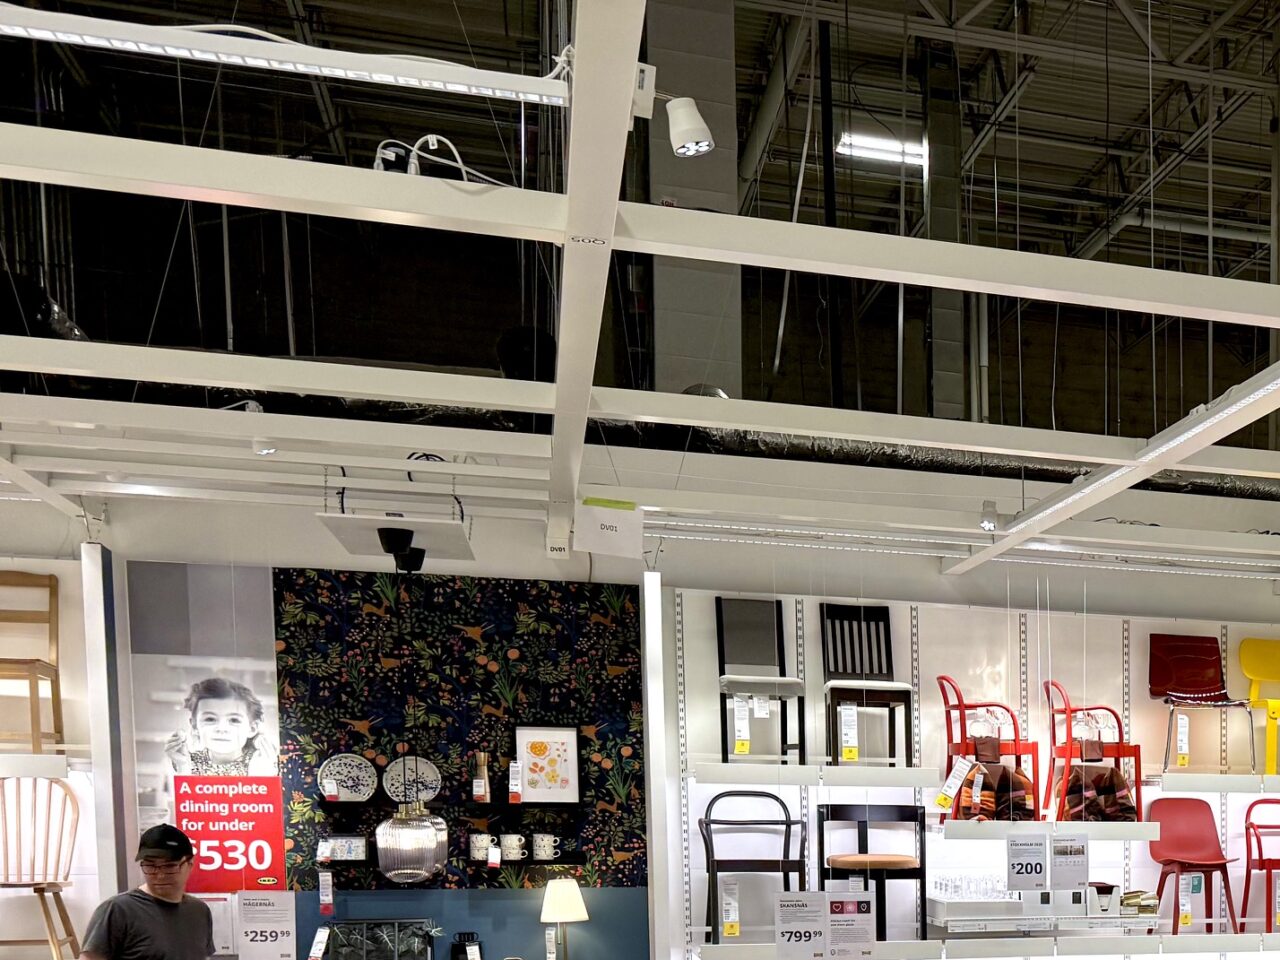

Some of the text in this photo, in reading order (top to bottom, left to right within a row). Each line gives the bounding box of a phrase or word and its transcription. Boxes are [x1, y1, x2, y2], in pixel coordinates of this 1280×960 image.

[600, 523, 618, 533] DV01
[179, 782, 268, 798] A complete
[180, 800, 274, 816] dining room
[181, 818, 256, 831] for under
[1011, 862, 1043, 875] $200
[244, 930, 291, 943] $259 99
[780, 930, 812, 943] $799
[813, 930, 823, 938] 99
